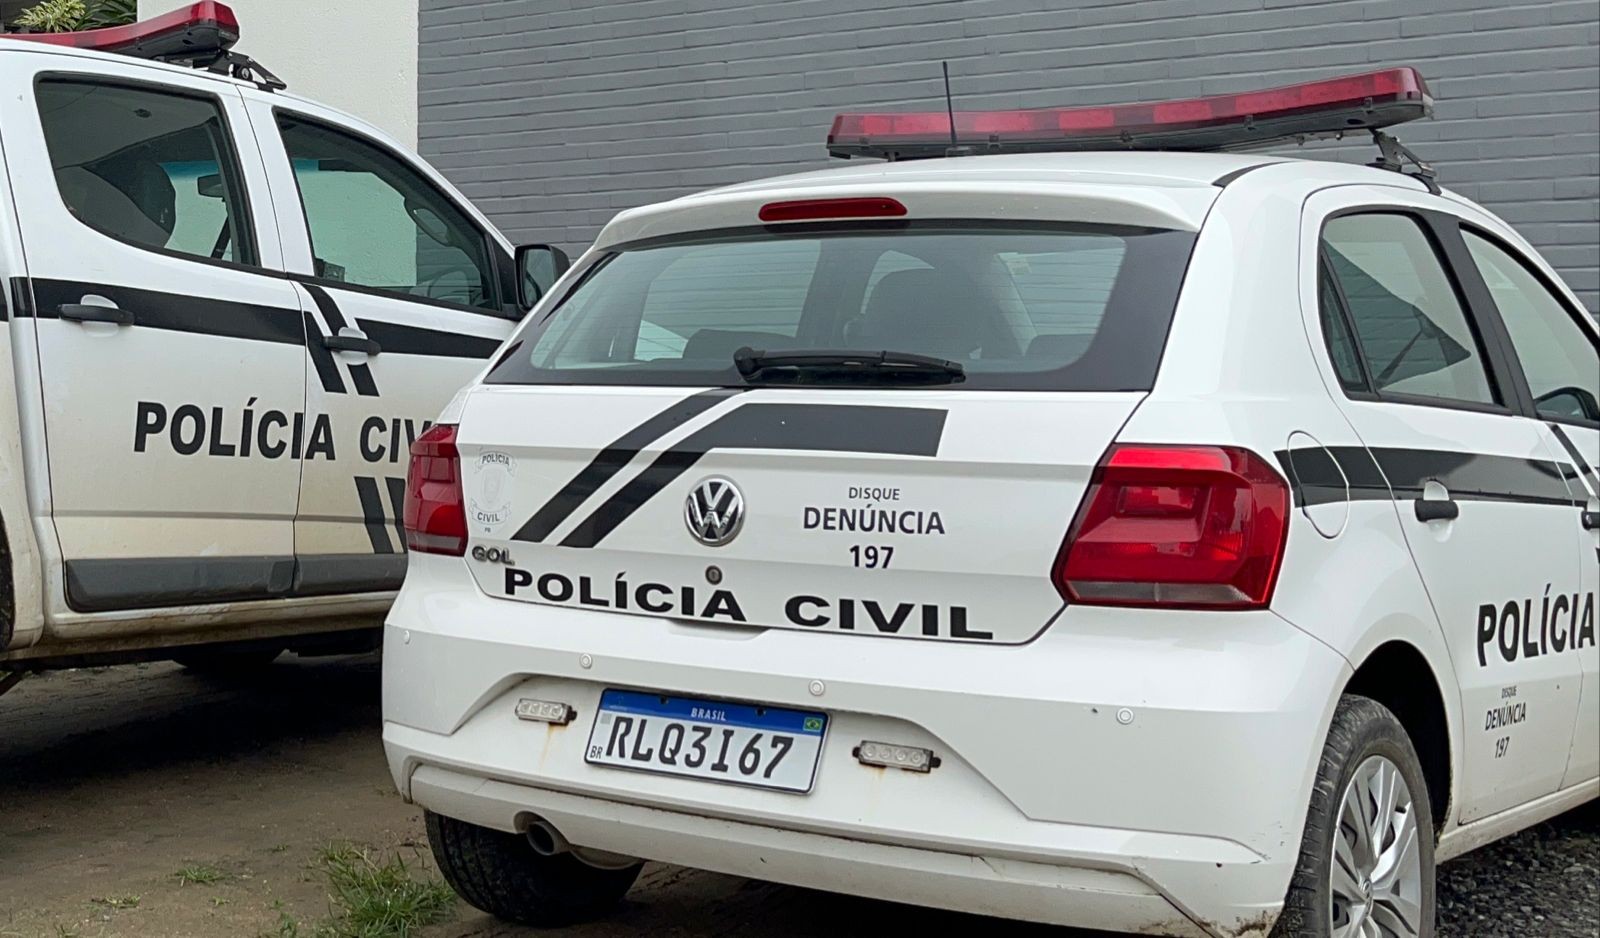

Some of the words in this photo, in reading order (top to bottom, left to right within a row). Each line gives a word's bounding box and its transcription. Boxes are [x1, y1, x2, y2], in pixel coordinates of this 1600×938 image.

[134, 397, 336, 461] POLÍCIA
[360, 416, 432, 463] CIV
[848, 487, 900, 502] DISQUE
[477, 512, 500, 523] CIVIL
[803, 504, 946, 535] DENÚNCIA
[471, 545, 515, 566] GOL
[848, 545, 895, 569] 197
[504, 567, 747, 622] POLÍCIA
[784, 595, 994, 640] CIVIL
[1477, 583, 1595, 667] POLÍCIA
[1501, 685, 1517, 699] DISQUE
[690, 707, 727, 722] BRASIL
[1485, 701, 1526, 731] DENÚNCIA
[590, 745, 603, 759] BR
[1495, 736, 1510, 758] 197
